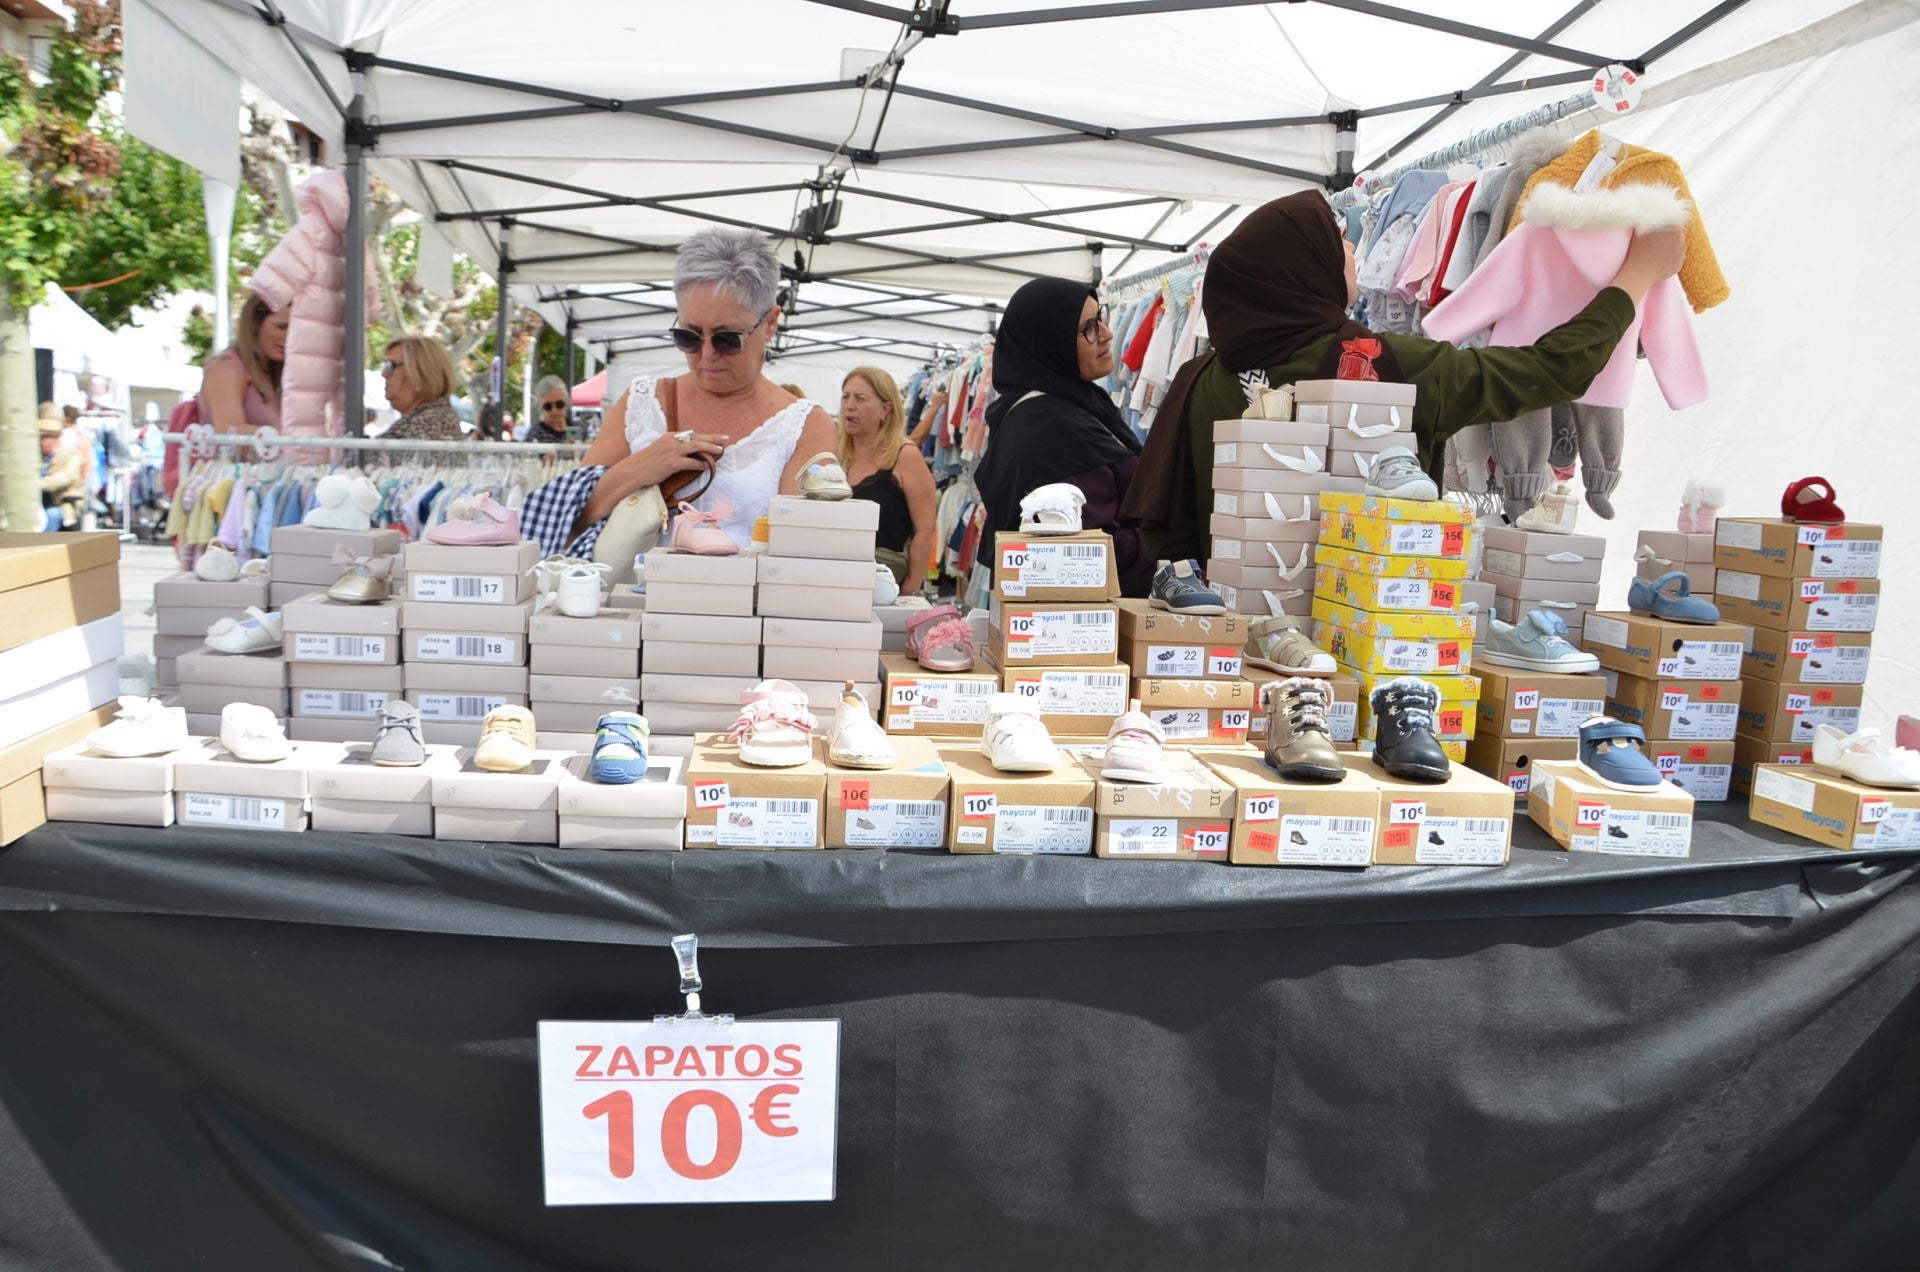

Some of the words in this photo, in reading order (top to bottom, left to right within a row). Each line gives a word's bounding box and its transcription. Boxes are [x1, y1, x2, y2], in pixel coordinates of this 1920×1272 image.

[1421, 528, 1434, 539] 22
[1445, 531, 1463, 541] 15€
[1804, 531, 1823, 543] 10€
[1006, 554, 1030, 567] 10€
[483, 584, 498, 594] 17
[1408, 583, 1420, 593] 23
[1803, 584, 1822, 595] 10€
[1433, 590, 1453, 601] 15€
[1012, 619, 1035, 631] 10€
[365, 644, 380, 653] 16
[487, 644, 502, 654] 18
[1795, 641, 1812, 652] 10€
[1183, 650, 1197, 661] 22
[1416, 648, 1428, 657] 26
[1439, 648, 1458, 659] 15€
[1217, 661, 1238, 673] 10€
[1661, 662, 1679, 673] 10€
[1045, 674, 1078, 682] mayoral
[920, 682, 948, 691] ayoral
[1018, 685, 1040, 697] 10€
[896, 689, 919, 702] 10€
[1517, 694, 1536, 706] 10€
[368, 700, 383, 709] 17
[1664, 696, 1682, 707] 10€
[1789, 698, 1808, 709] 10€
[1187, 712, 1200, 723] 22
[1225, 714, 1248, 725] 10€
[1443, 717, 1462, 727] 15€
[1659, 757, 1678, 768] 10€
[1511, 779, 1527, 791] 10€
[699, 786, 727, 802] 10€
[841, 789, 869, 801] 10€
[967, 798, 994, 812] 10€
[1249, 800, 1275, 814] 10€
[263, 807, 280, 819] 17
[999, 809, 1037, 818] mayoral
[1399, 806, 1424, 820] 10€
[1582, 808, 1606, 822] 10€
[1869, 806, 1889, 818] 10€
[1285, 818, 1321, 827] mayoral
[1423, 819, 1458, 828] mayoral
[1151, 826, 1168, 837] 22
[1197, 834, 1223, 847] 10€
[575, 1043, 803, 1078] ZAPATOS
[582, 1083, 800, 1181] 10€
